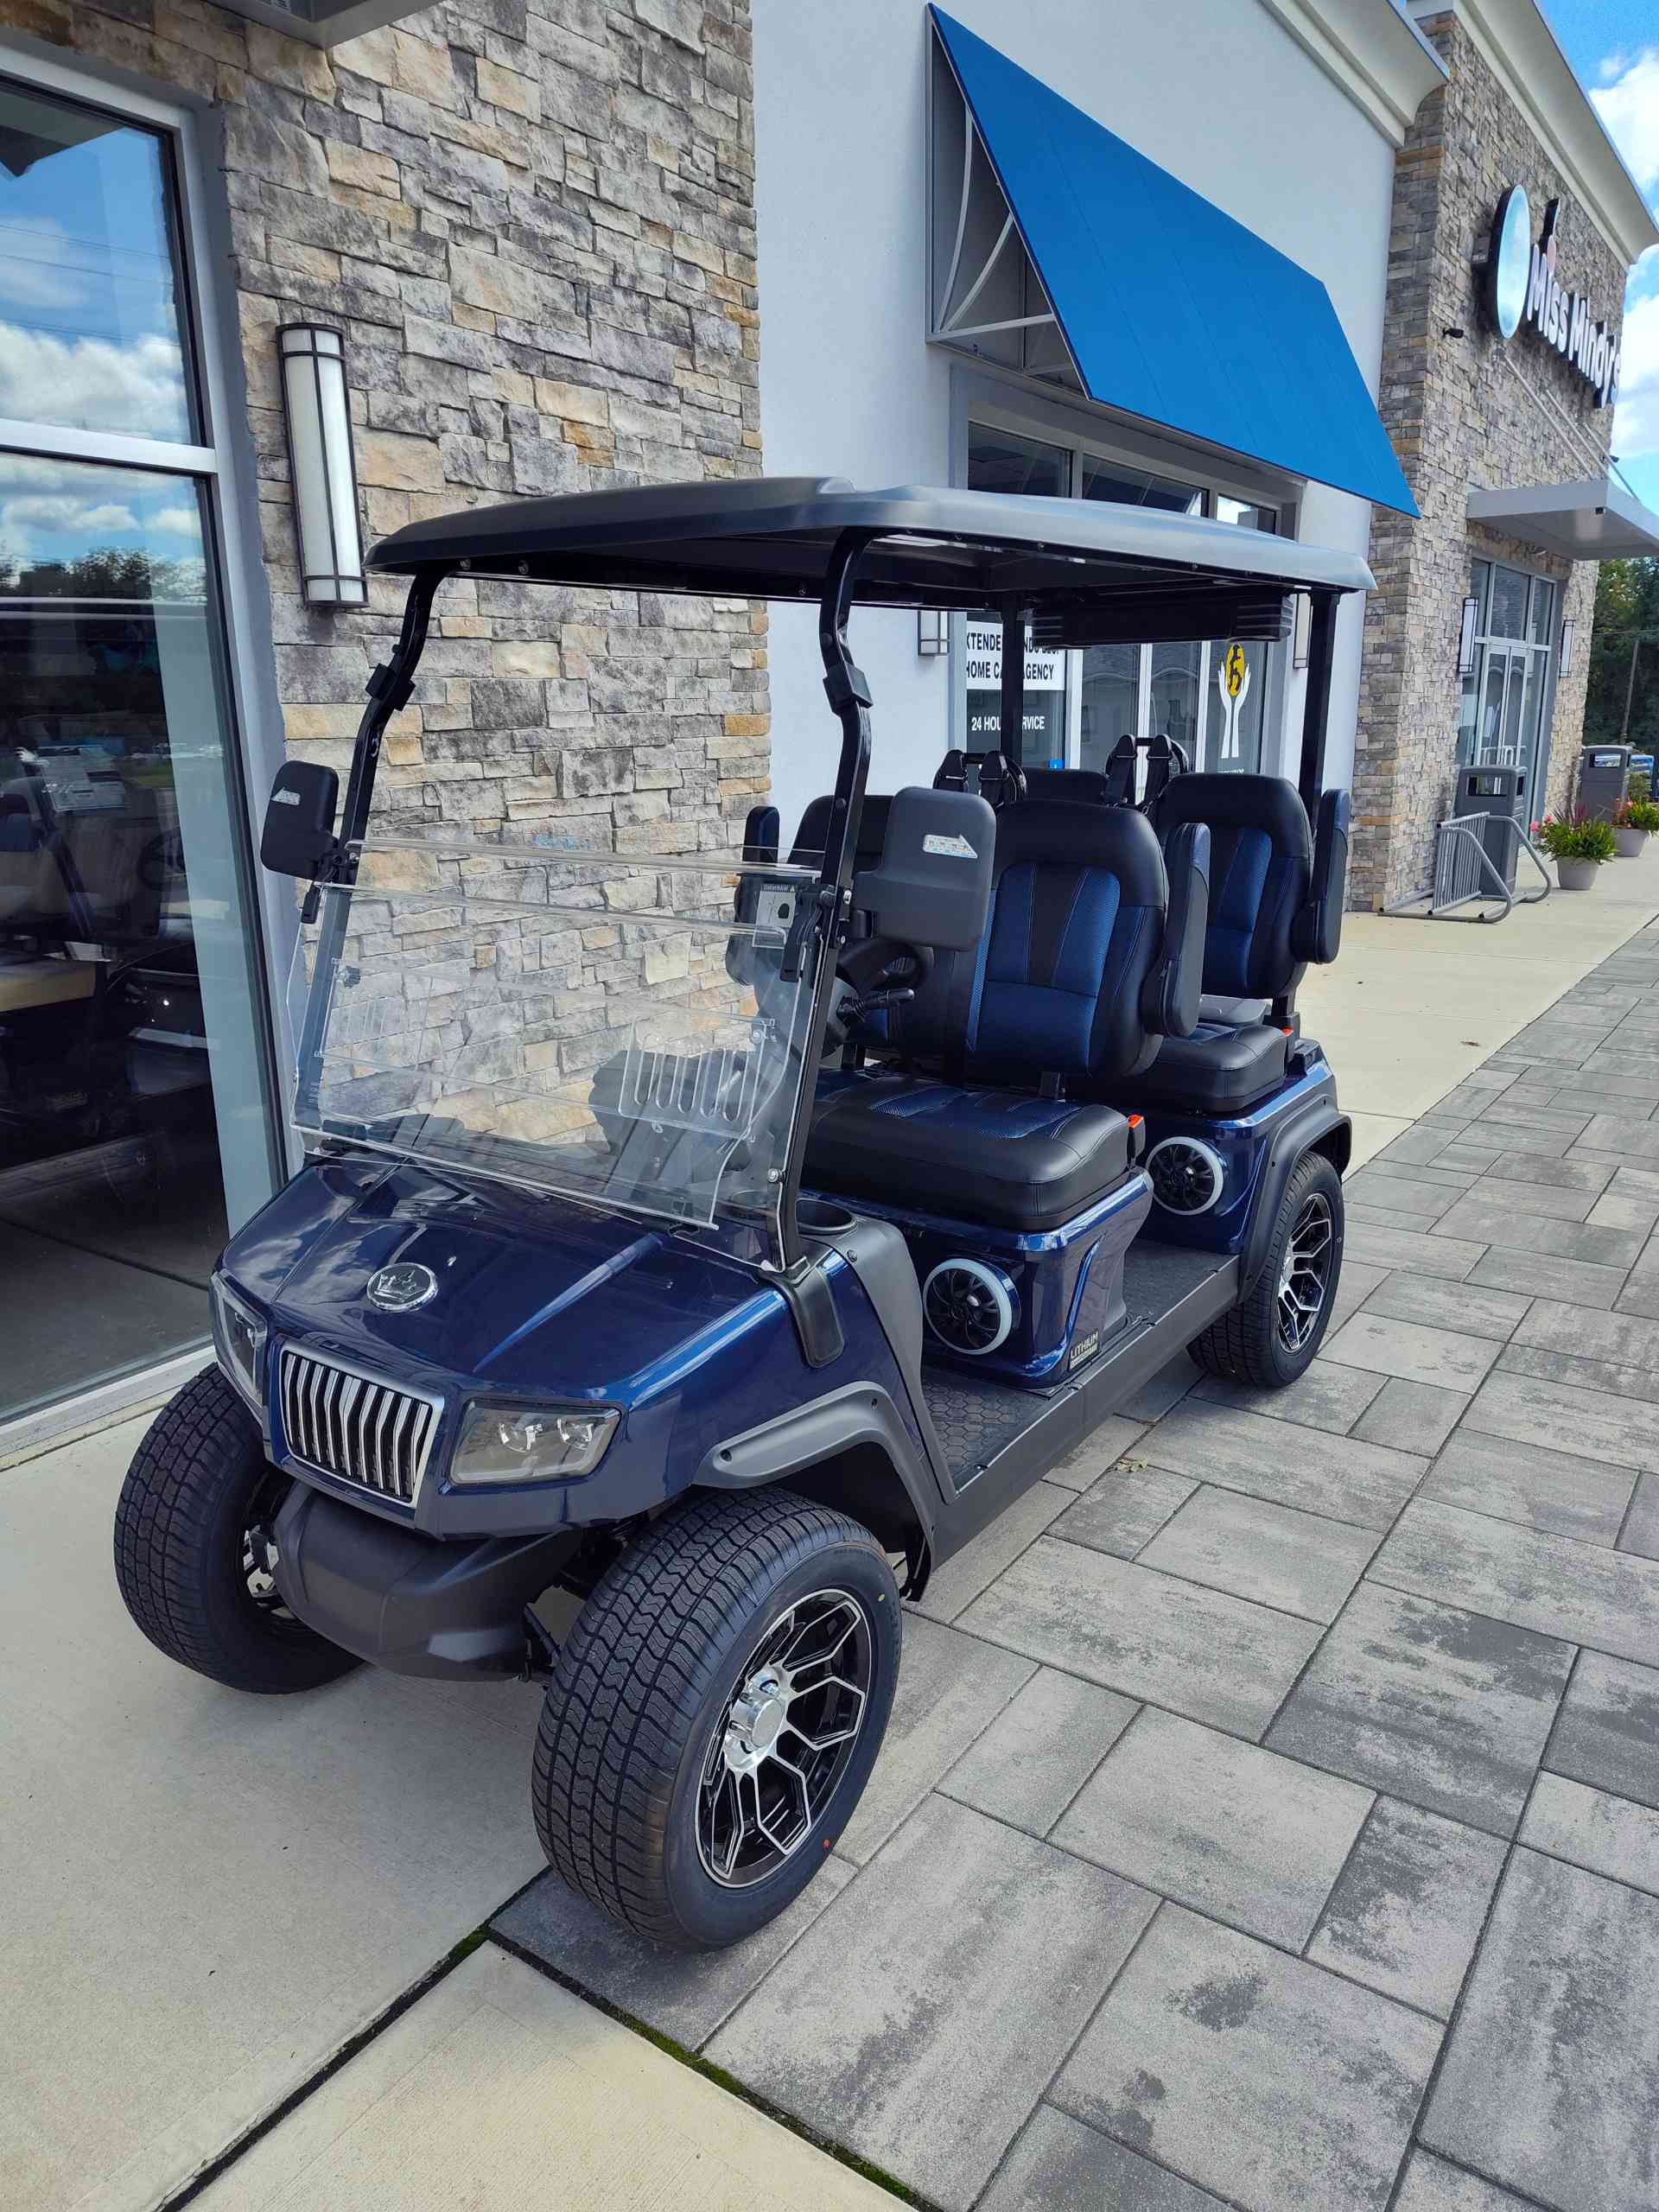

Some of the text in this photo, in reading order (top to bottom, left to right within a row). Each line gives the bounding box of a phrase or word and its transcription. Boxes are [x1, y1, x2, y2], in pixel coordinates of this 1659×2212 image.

[967, 632, 1001, 652] XTENDE
[1023, 663, 1054, 680] GENCY
[971, 715, 1046, 731] 24 HOU RVICE
[1071, 1332, 1098, 1359] LITHIUM
